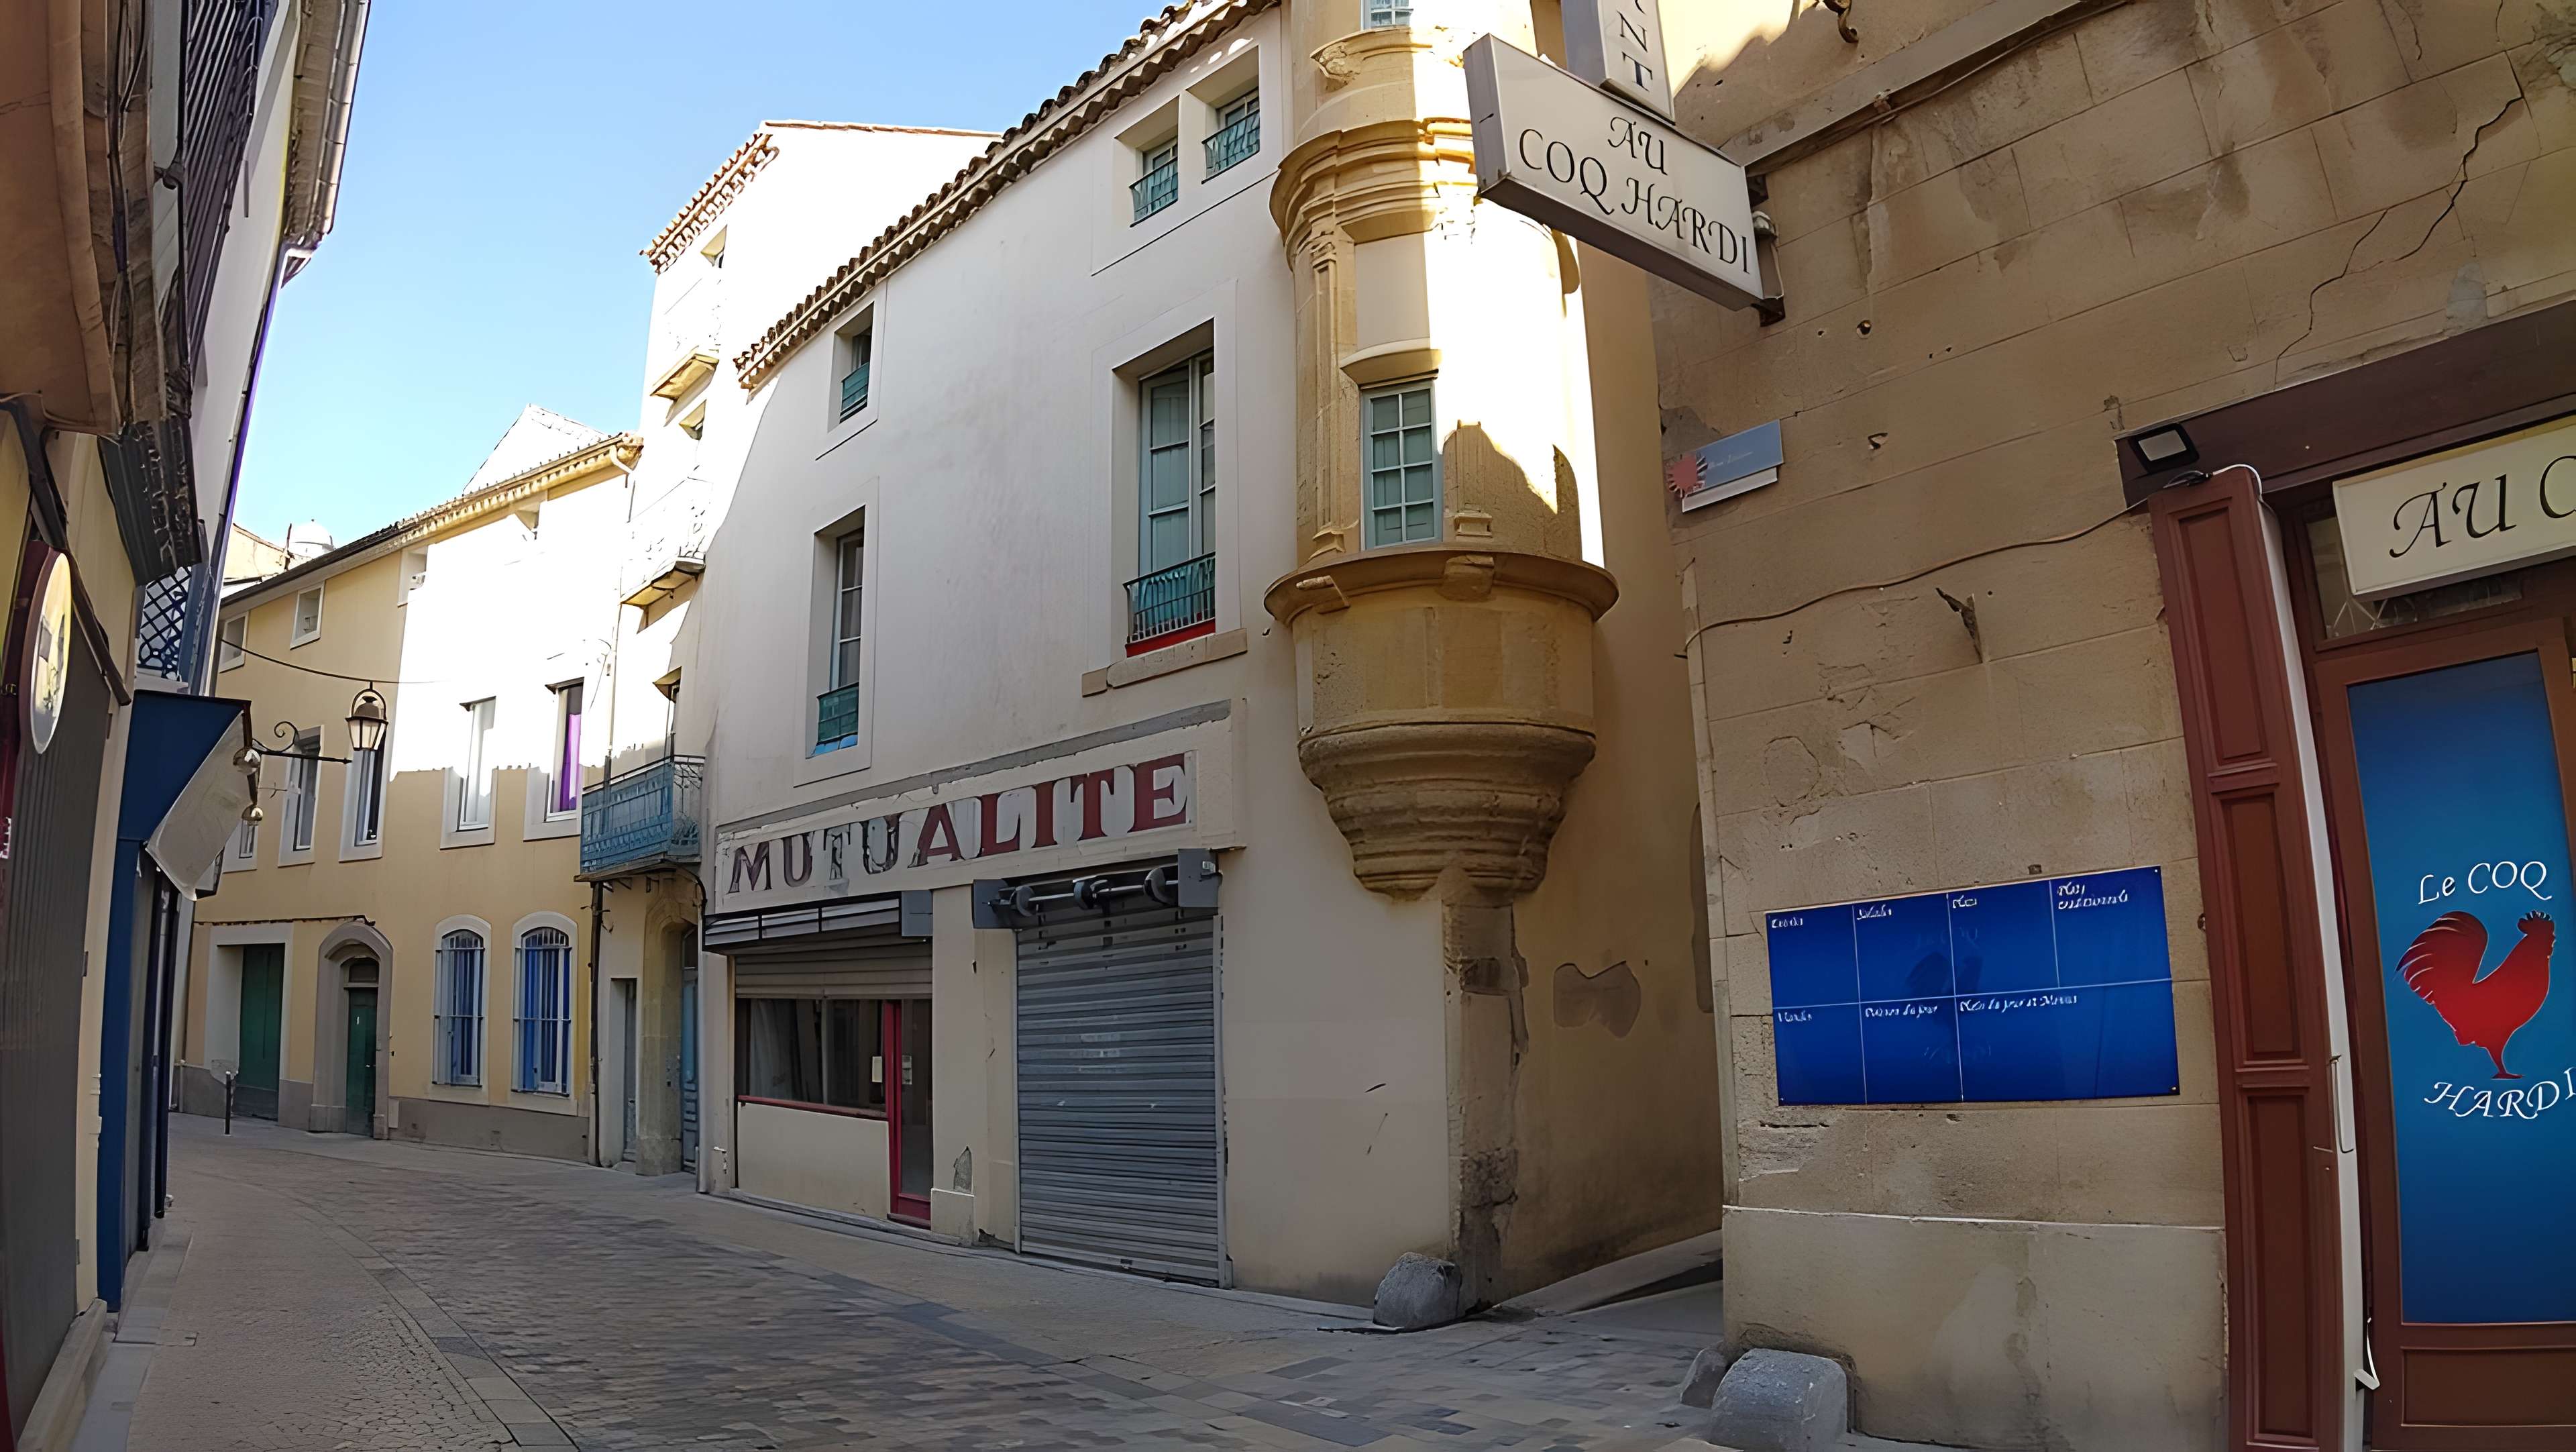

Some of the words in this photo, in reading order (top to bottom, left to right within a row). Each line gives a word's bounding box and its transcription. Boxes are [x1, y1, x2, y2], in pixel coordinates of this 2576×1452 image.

[1617, 0, 1654, 92] NT
[1607, 115, 1669, 176] AU
[1518, 128, 1615, 215] COQ
[1621, 176, 1751, 274] HARDI
[2388, 473, 2518, 559] AU
[727, 751, 1188, 894] MUTUALITE
[2416, 874, 2456, 905] Le
[2467, 860, 2553, 901] COQ
[2423, 1066, 2576, 1120] HARDI
